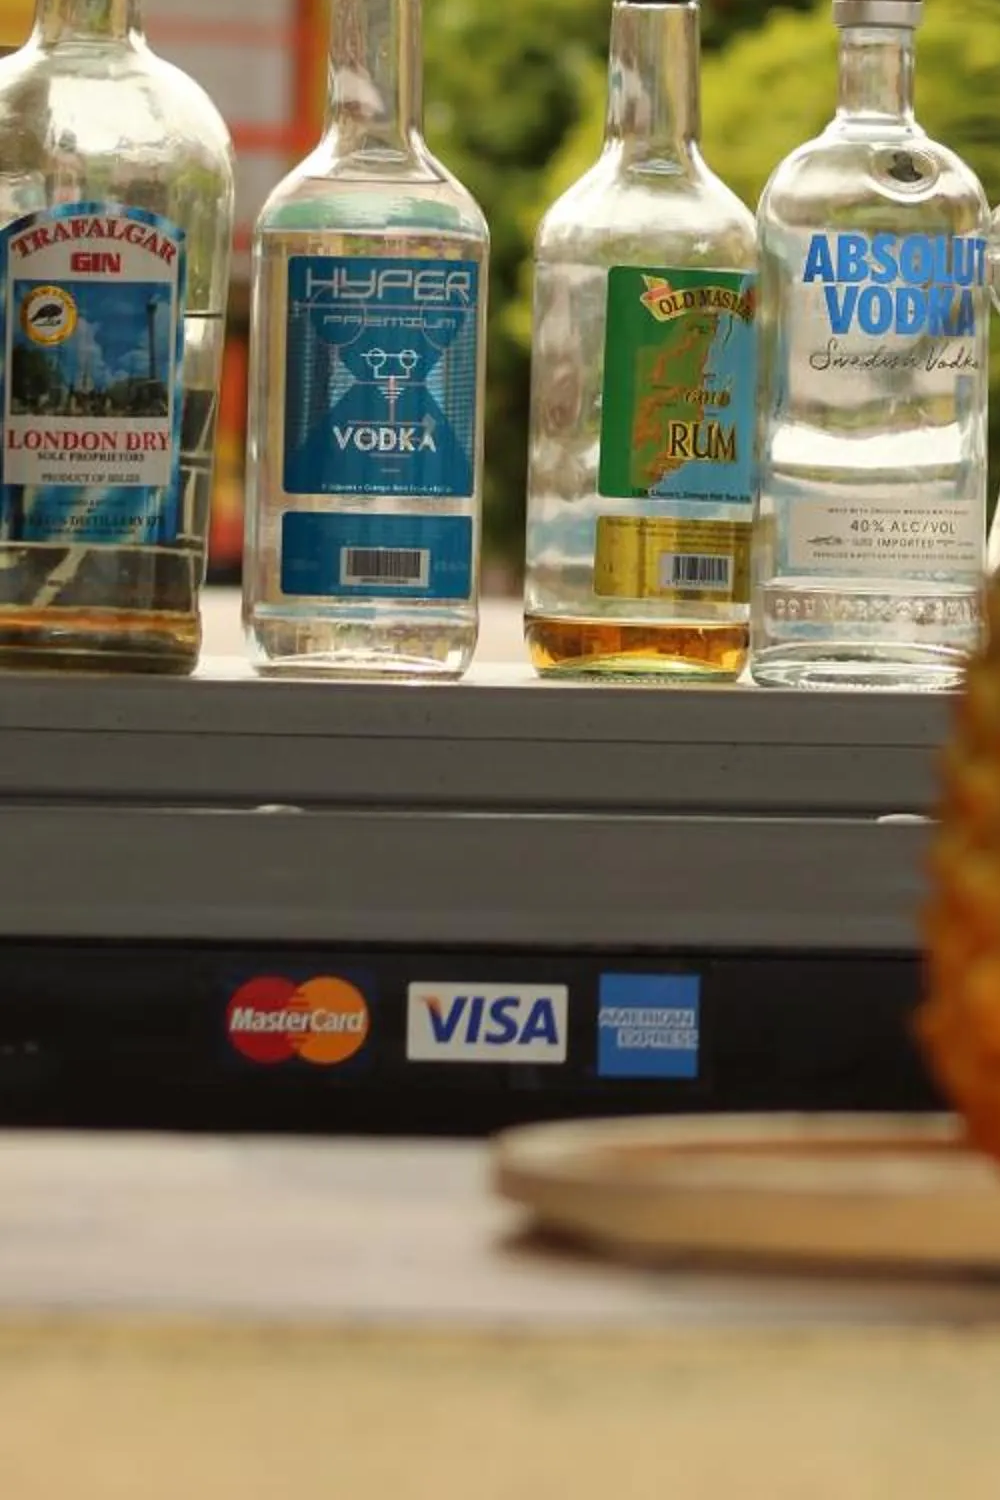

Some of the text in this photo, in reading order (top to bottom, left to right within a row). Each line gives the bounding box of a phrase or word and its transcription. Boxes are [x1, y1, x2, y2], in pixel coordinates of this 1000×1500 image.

[11, 218, 177, 266] TRAFALGAR
[70, 253, 121, 273] GIN
[803, 234, 987, 286] ABSOLUT
[306, 267, 470, 301] HYPER
[659, 292, 695, 316] OLD
[824, 286, 976, 337] VODKA
[7, 429, 169, 451] LONDON DRY
[332, 425, 436, 453] VODKA
[669, 422, 738, 460] RUM
[850, 519, 957, 534] 40% ALC/VOL
[229, 1007, 365, 1034] MasterCard
[418, 995, 559, 1046] VISA
